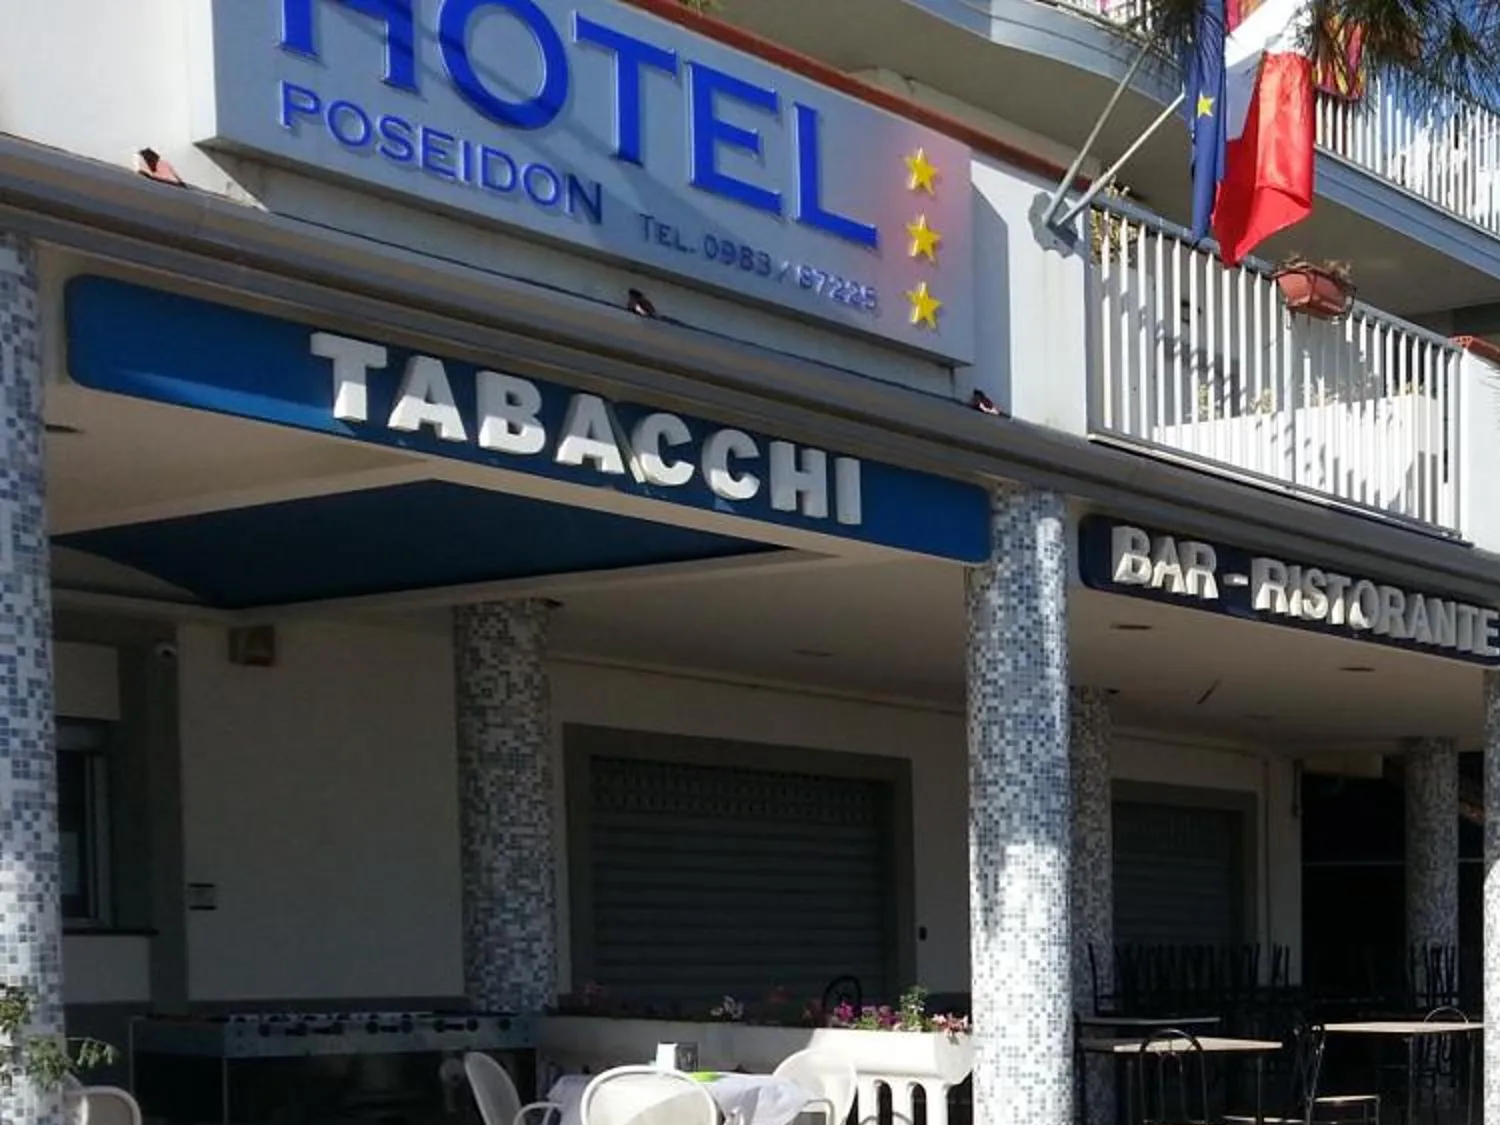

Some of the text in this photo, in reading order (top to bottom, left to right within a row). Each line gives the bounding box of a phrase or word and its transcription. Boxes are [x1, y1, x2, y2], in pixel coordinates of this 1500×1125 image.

[277, 0, 878, 248] HOTEL
[279, 80, 603, 225] POSEIDON
[639, 213, 697, 255] TEL.
[310, 332, 863, 525] TABACCHI
[1112, 525, 1219, 599] BAR
[1251, 557, 1500, 657] RISTORANTE
